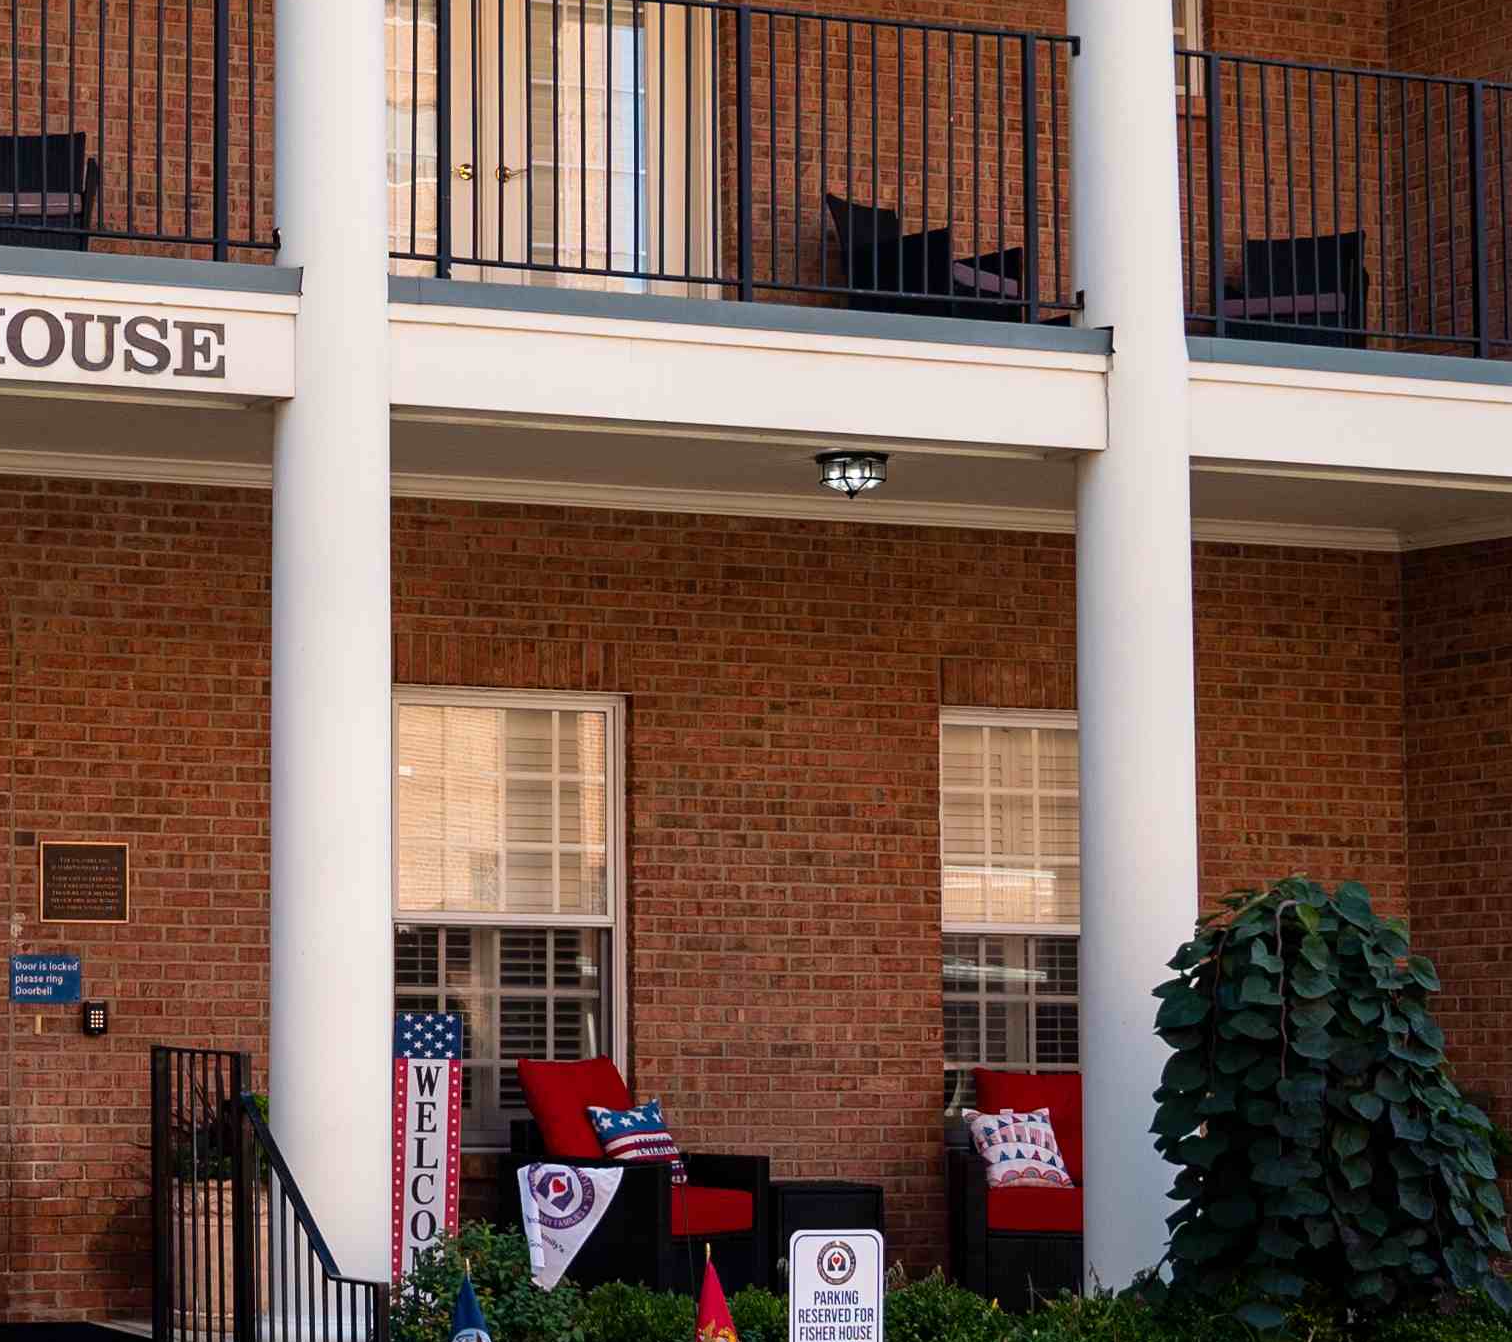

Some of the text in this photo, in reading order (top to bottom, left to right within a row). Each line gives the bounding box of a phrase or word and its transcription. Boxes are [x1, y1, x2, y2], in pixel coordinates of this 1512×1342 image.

[15, 961, 78, 971] Door is locked
[15, 974, 64, 986] please ring
[15, 986, 52, 996] Doorbell
[409, 1064, 443, 1304] WELCO
[814, 1290, 859, 1305] PARKING
[798, 1308, 874, 1323] RESERVED FOR
[799, 1325, 872, 1341] FISHER HOUSE
